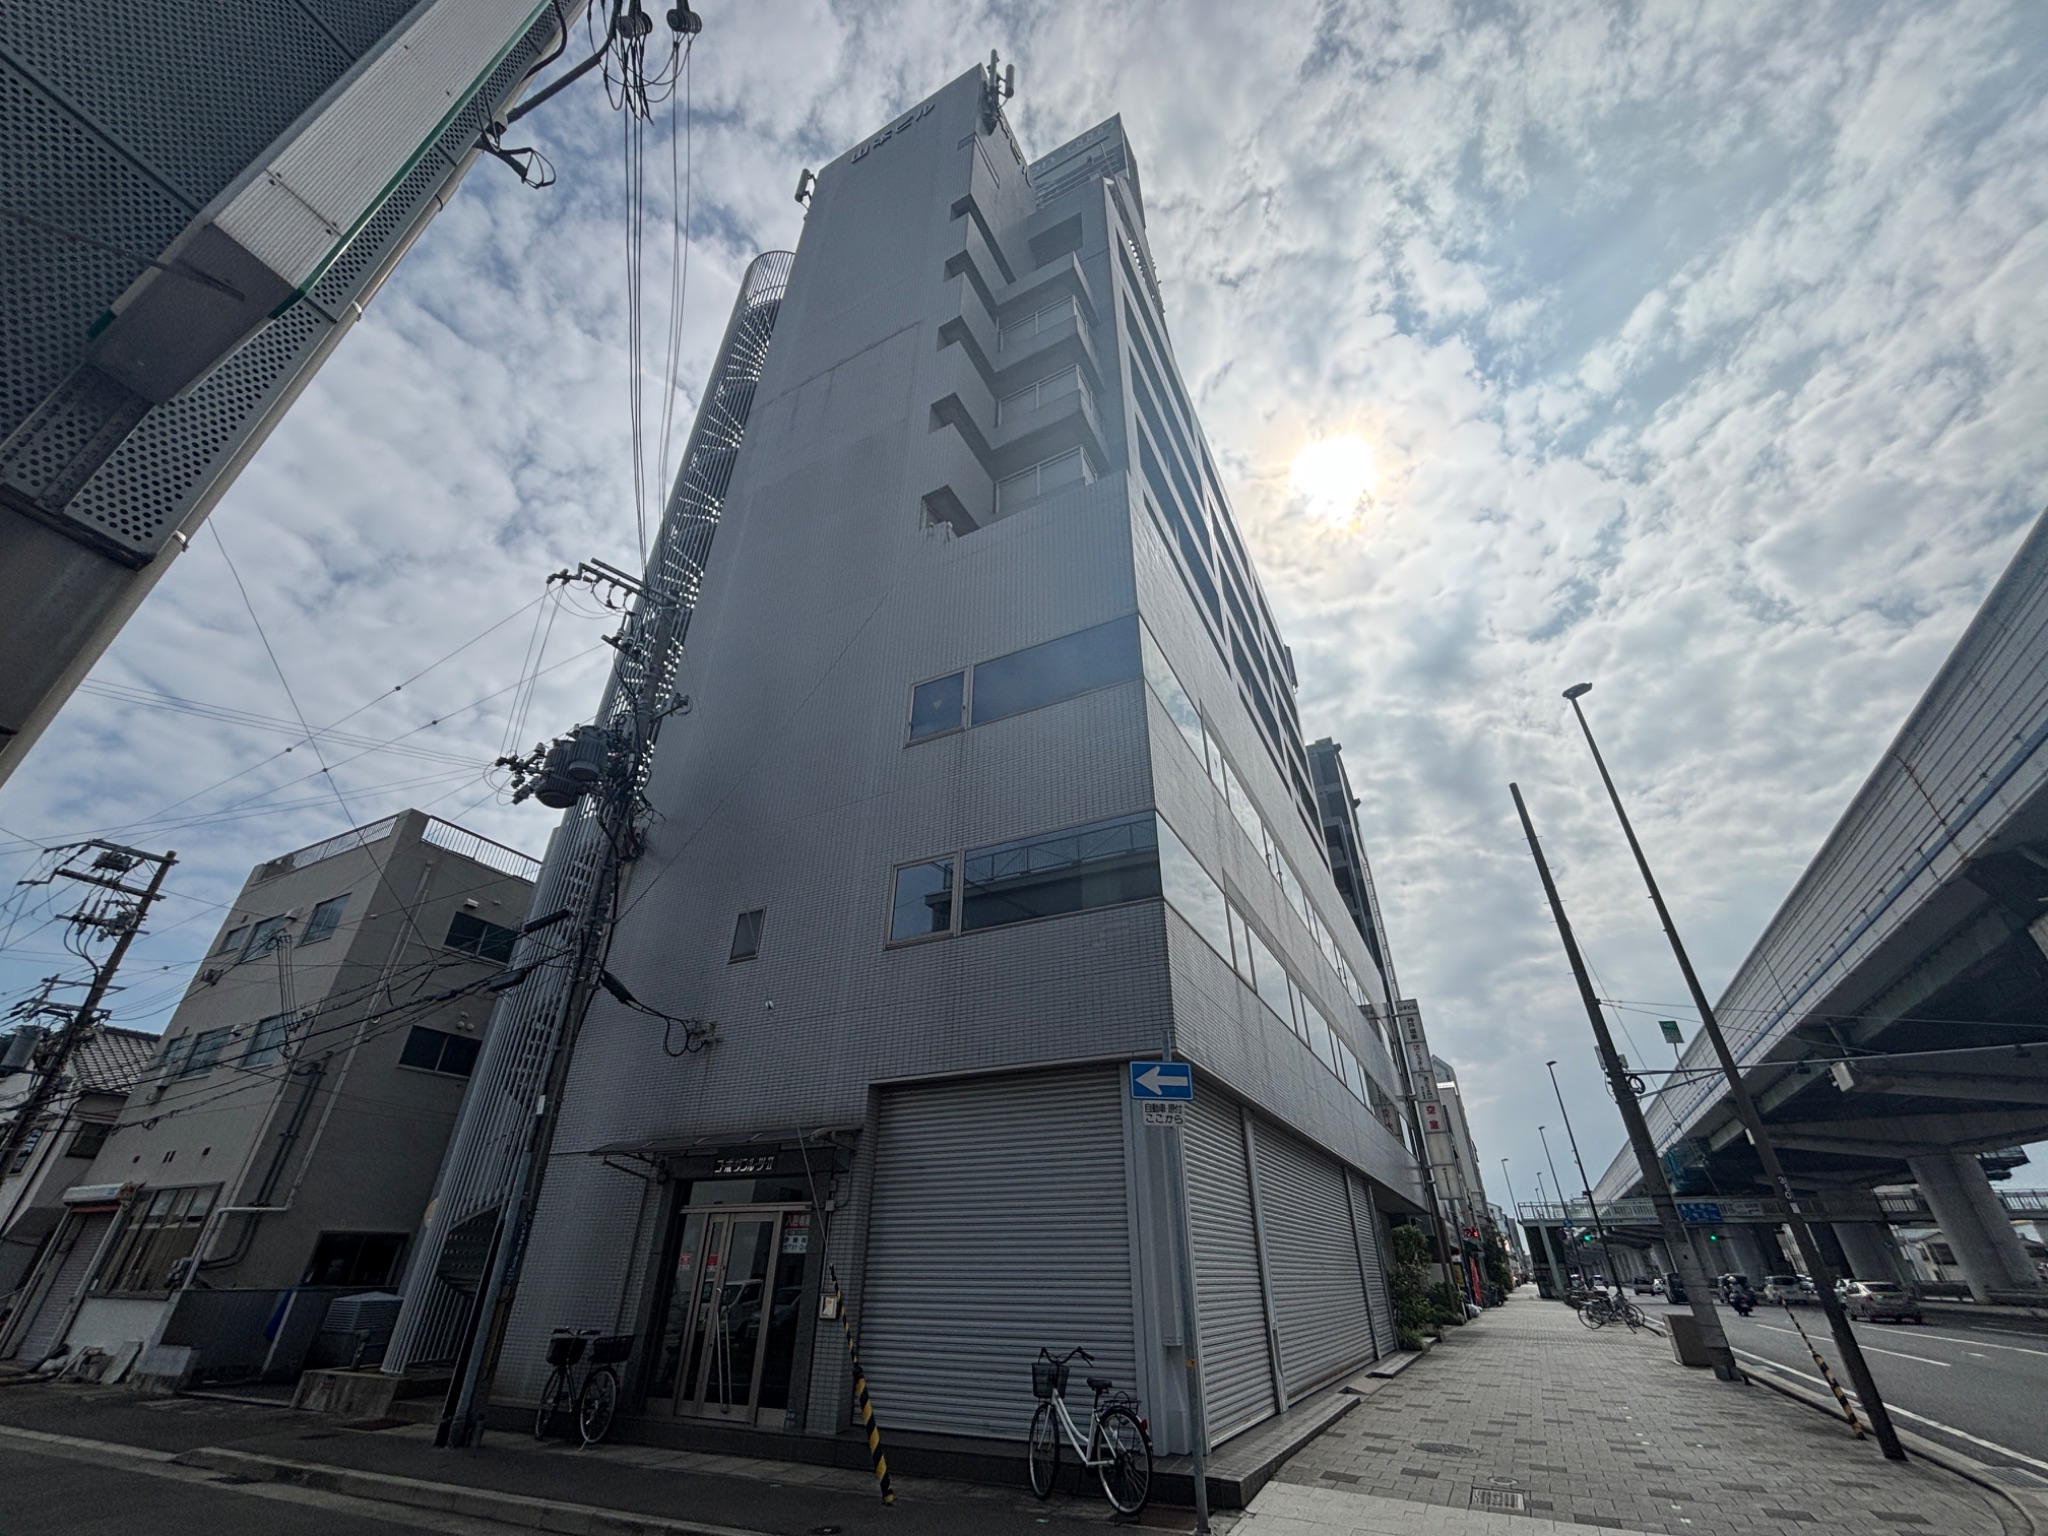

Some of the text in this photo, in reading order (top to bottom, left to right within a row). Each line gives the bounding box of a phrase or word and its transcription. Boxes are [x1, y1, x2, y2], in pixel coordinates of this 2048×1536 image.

[850, 104, 936, 164] 山本ビル
[1145, 1114, 1184, 1124] ここから
